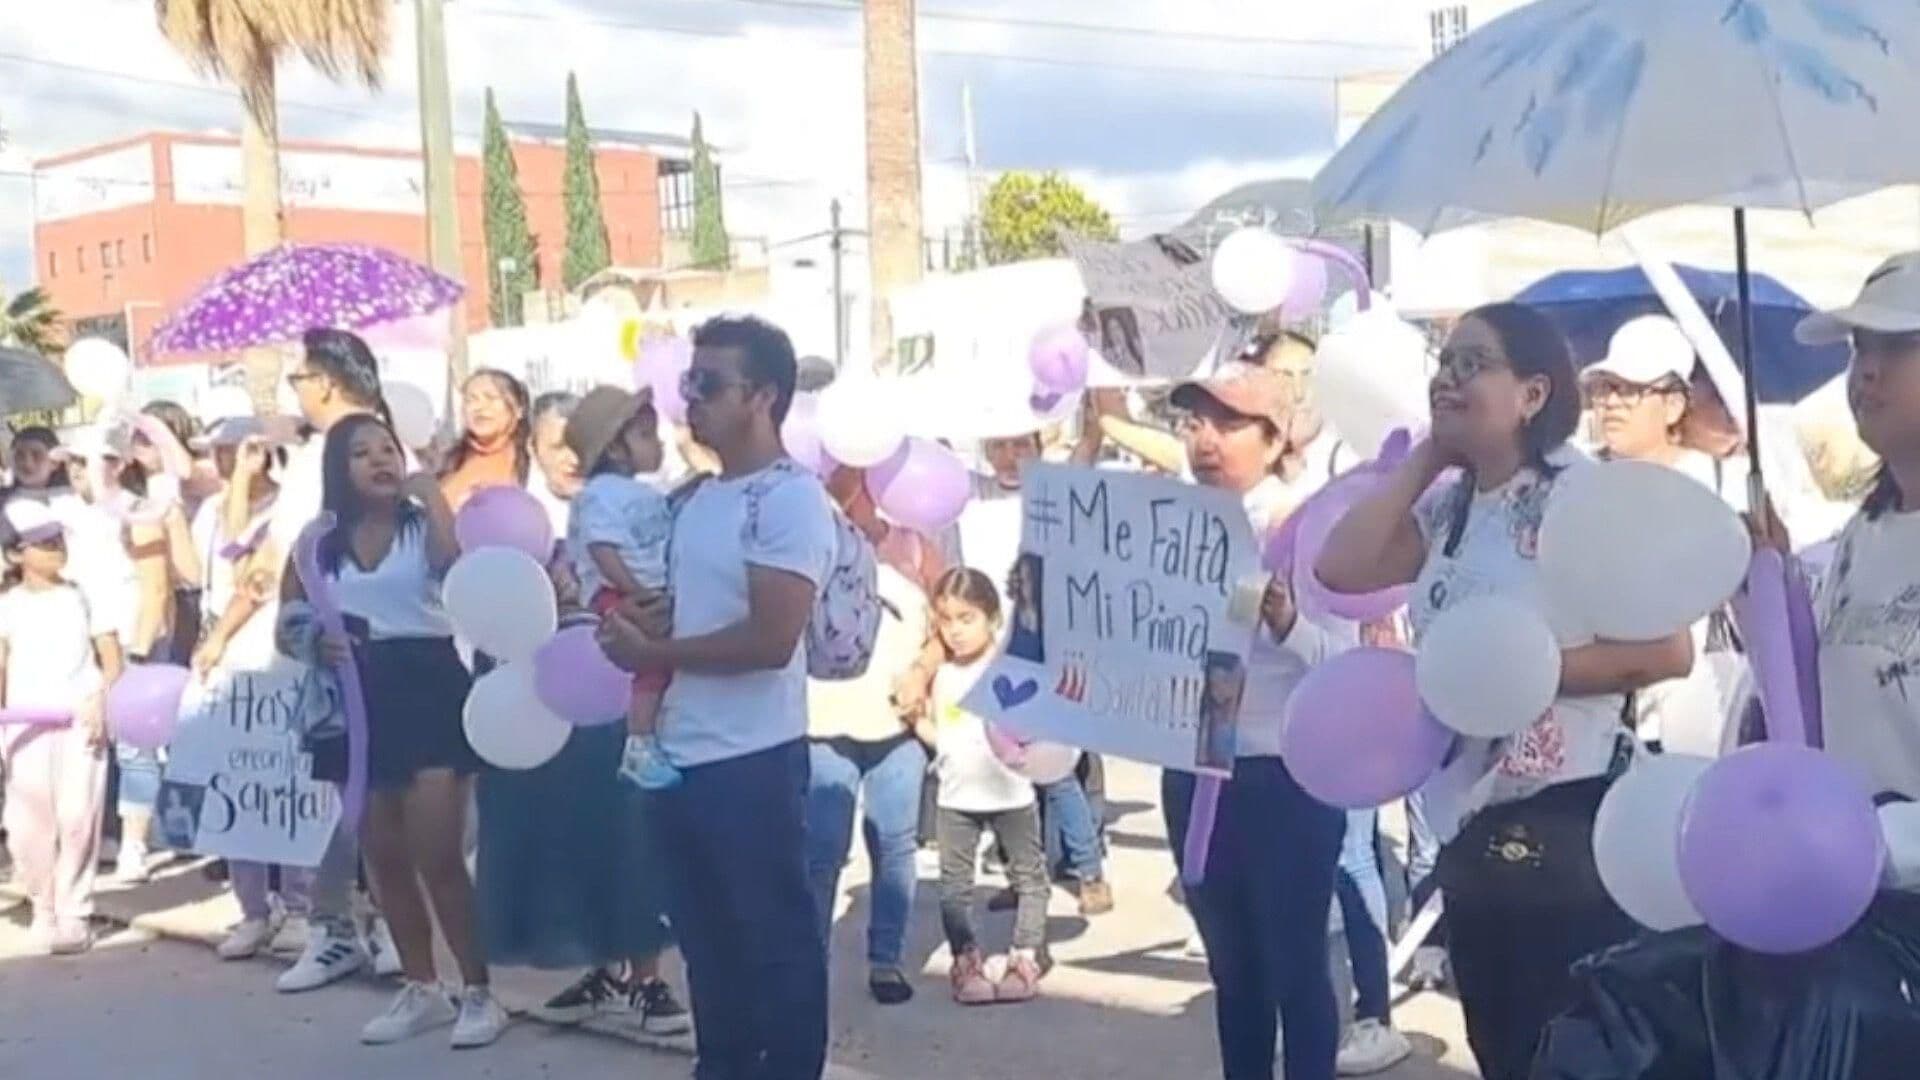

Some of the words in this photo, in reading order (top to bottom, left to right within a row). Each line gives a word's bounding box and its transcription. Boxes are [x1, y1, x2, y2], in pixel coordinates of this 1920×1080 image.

[1029, 479, 1132, 562] #Me
[1150, 498, 1229, 597] Falta
[1066, 570, 1113, 641] Mi
